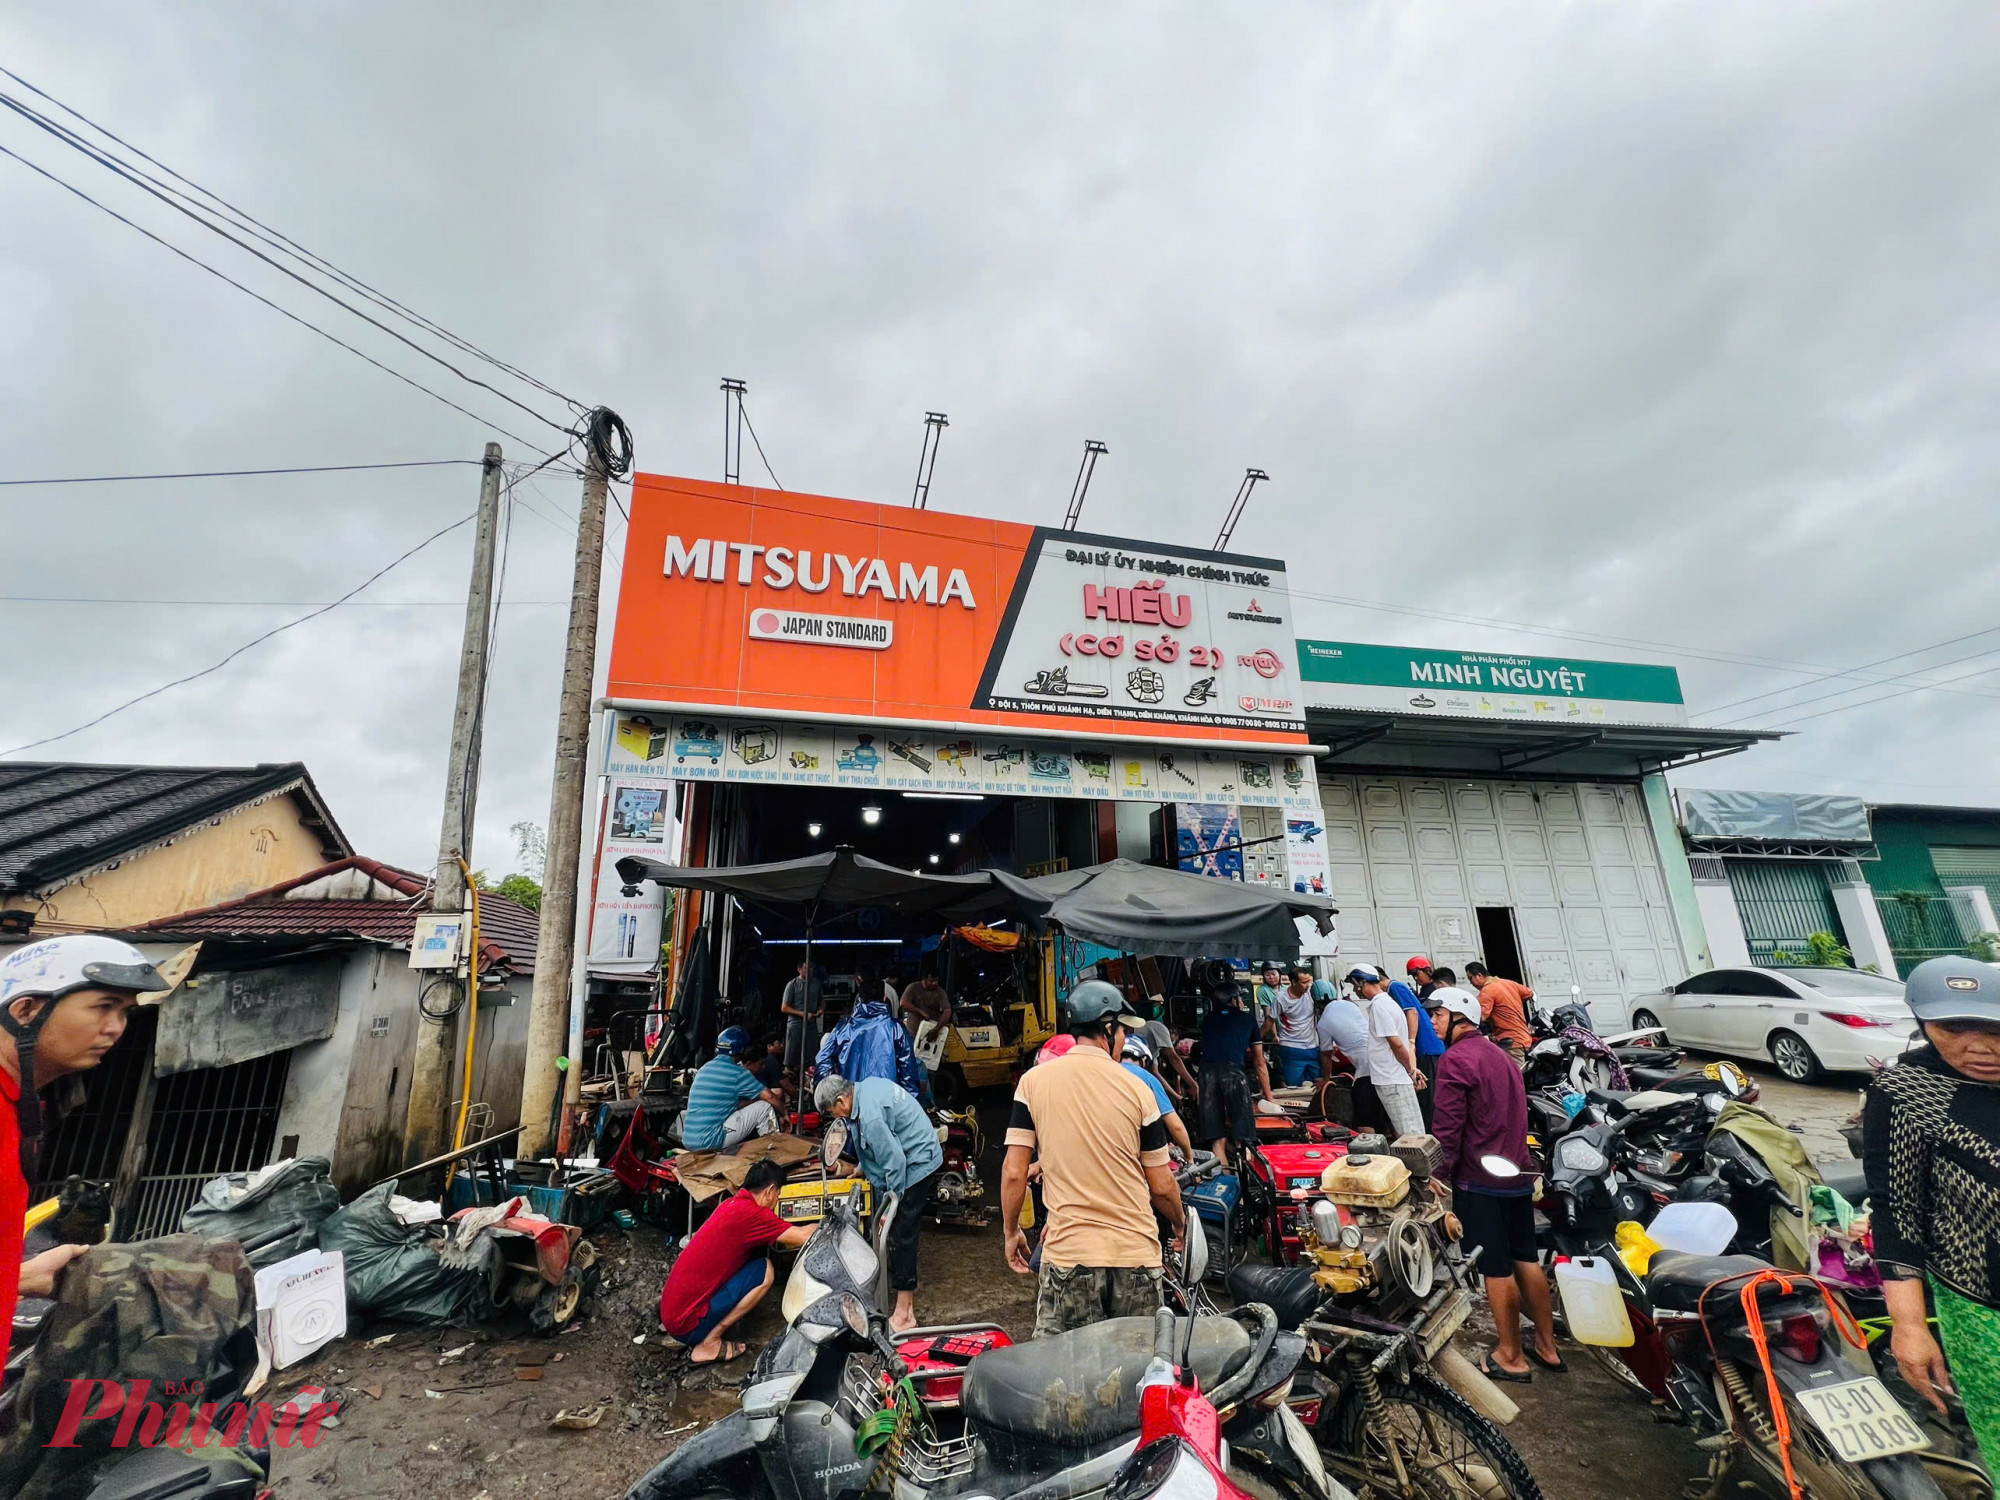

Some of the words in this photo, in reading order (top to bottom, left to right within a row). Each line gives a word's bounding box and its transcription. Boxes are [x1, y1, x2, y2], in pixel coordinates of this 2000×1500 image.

[663, 535, 977, 610] MITSUYAMA
[1066, 549, 1093, 565] ĐẠI
[1095, 551, 1111, 566] LÝ
[1114, 552, 1136, 569] ỦY
[1139, 558, 1184, 576] NHIỆM
[1187, 565, 1230, 582] CHÍNH
[1232, 571, 1270, 587] THỨC
[1084, 579, 1192, 628] HIẾU
[782, 616, 824, 637] JAPAN
[826, 621, 887, 642] STANDARD
[1189, 645, 1225, 670] 2)
[1310, 648, 1343, 656] HEINEKEN
[1461, 655, 1477, 663] NHÀ
[1478, 656, 1499, 664] PHÂN
[1499, 657, 1516, 665] PHỐI
[1517, 659, 1531, 667] NT7
[1410, 661, 1482, 686] MINH
[1490, 666, 1586, 696] NGUYỆT
[1021, 702, 1040, 711] THÔN
[1042, 702, 1056, 712] PHÚ
[1058, 703, 1081, 713] KHÁNH
[1178, 714, 1200, 723] KHÁNH
[671, 765, 688, 777] MÁY
[689, 767, 705, 777] BƠM
[1829, 1414, 1921, 1457] 278.89
[813, 1461, 862, 1479] HONDA
